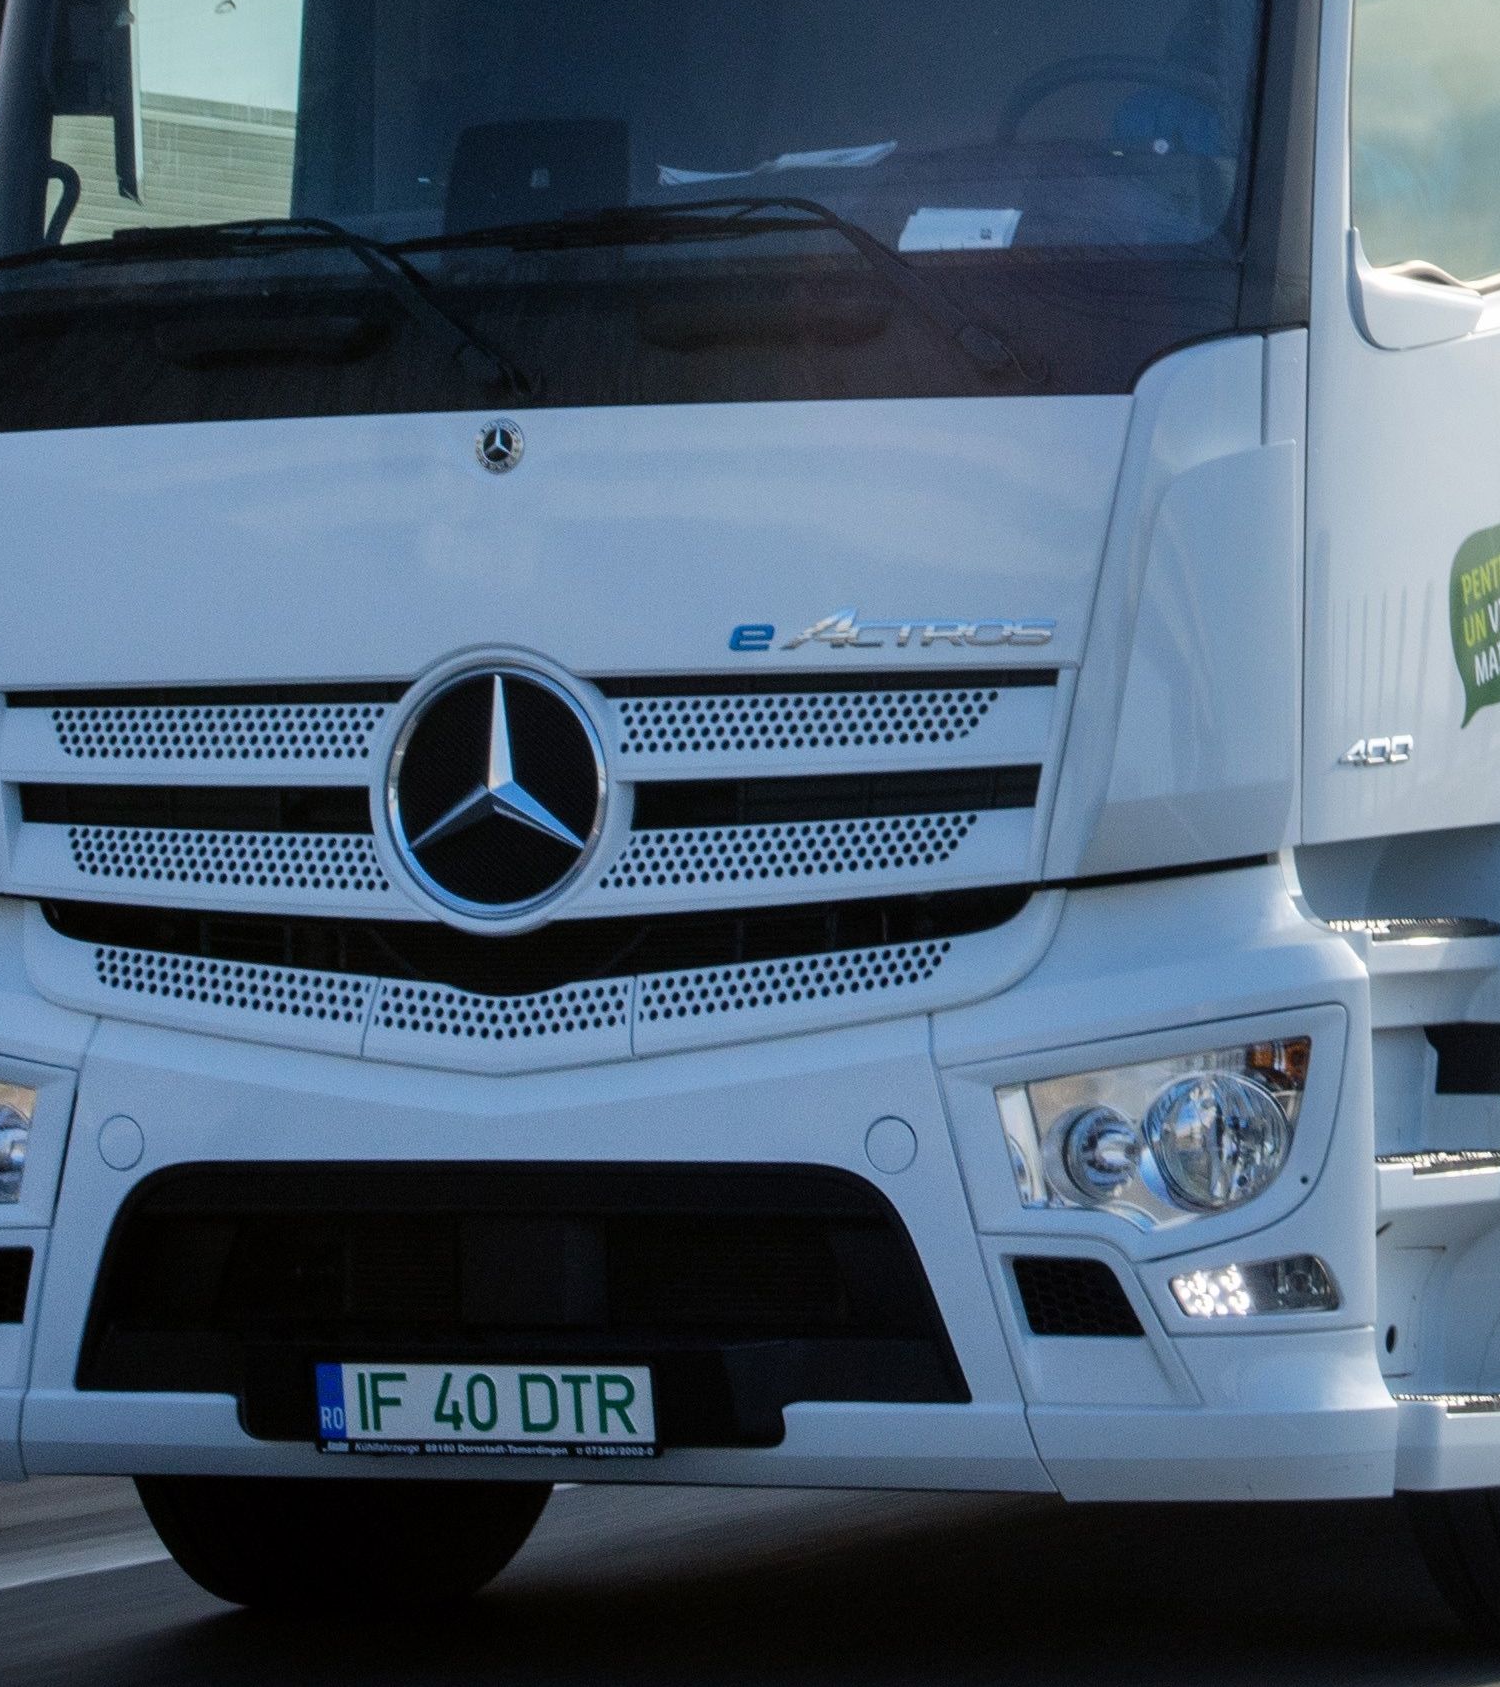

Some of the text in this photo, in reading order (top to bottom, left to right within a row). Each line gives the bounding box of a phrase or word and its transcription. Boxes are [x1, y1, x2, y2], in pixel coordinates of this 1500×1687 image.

[1462, 611, 1488, 648] UN
[1344, 735, 1412, 764] 400
[320, 1407, 344, 1431] RO
[357, 1372, 638, 1434] IF 40 DTR
